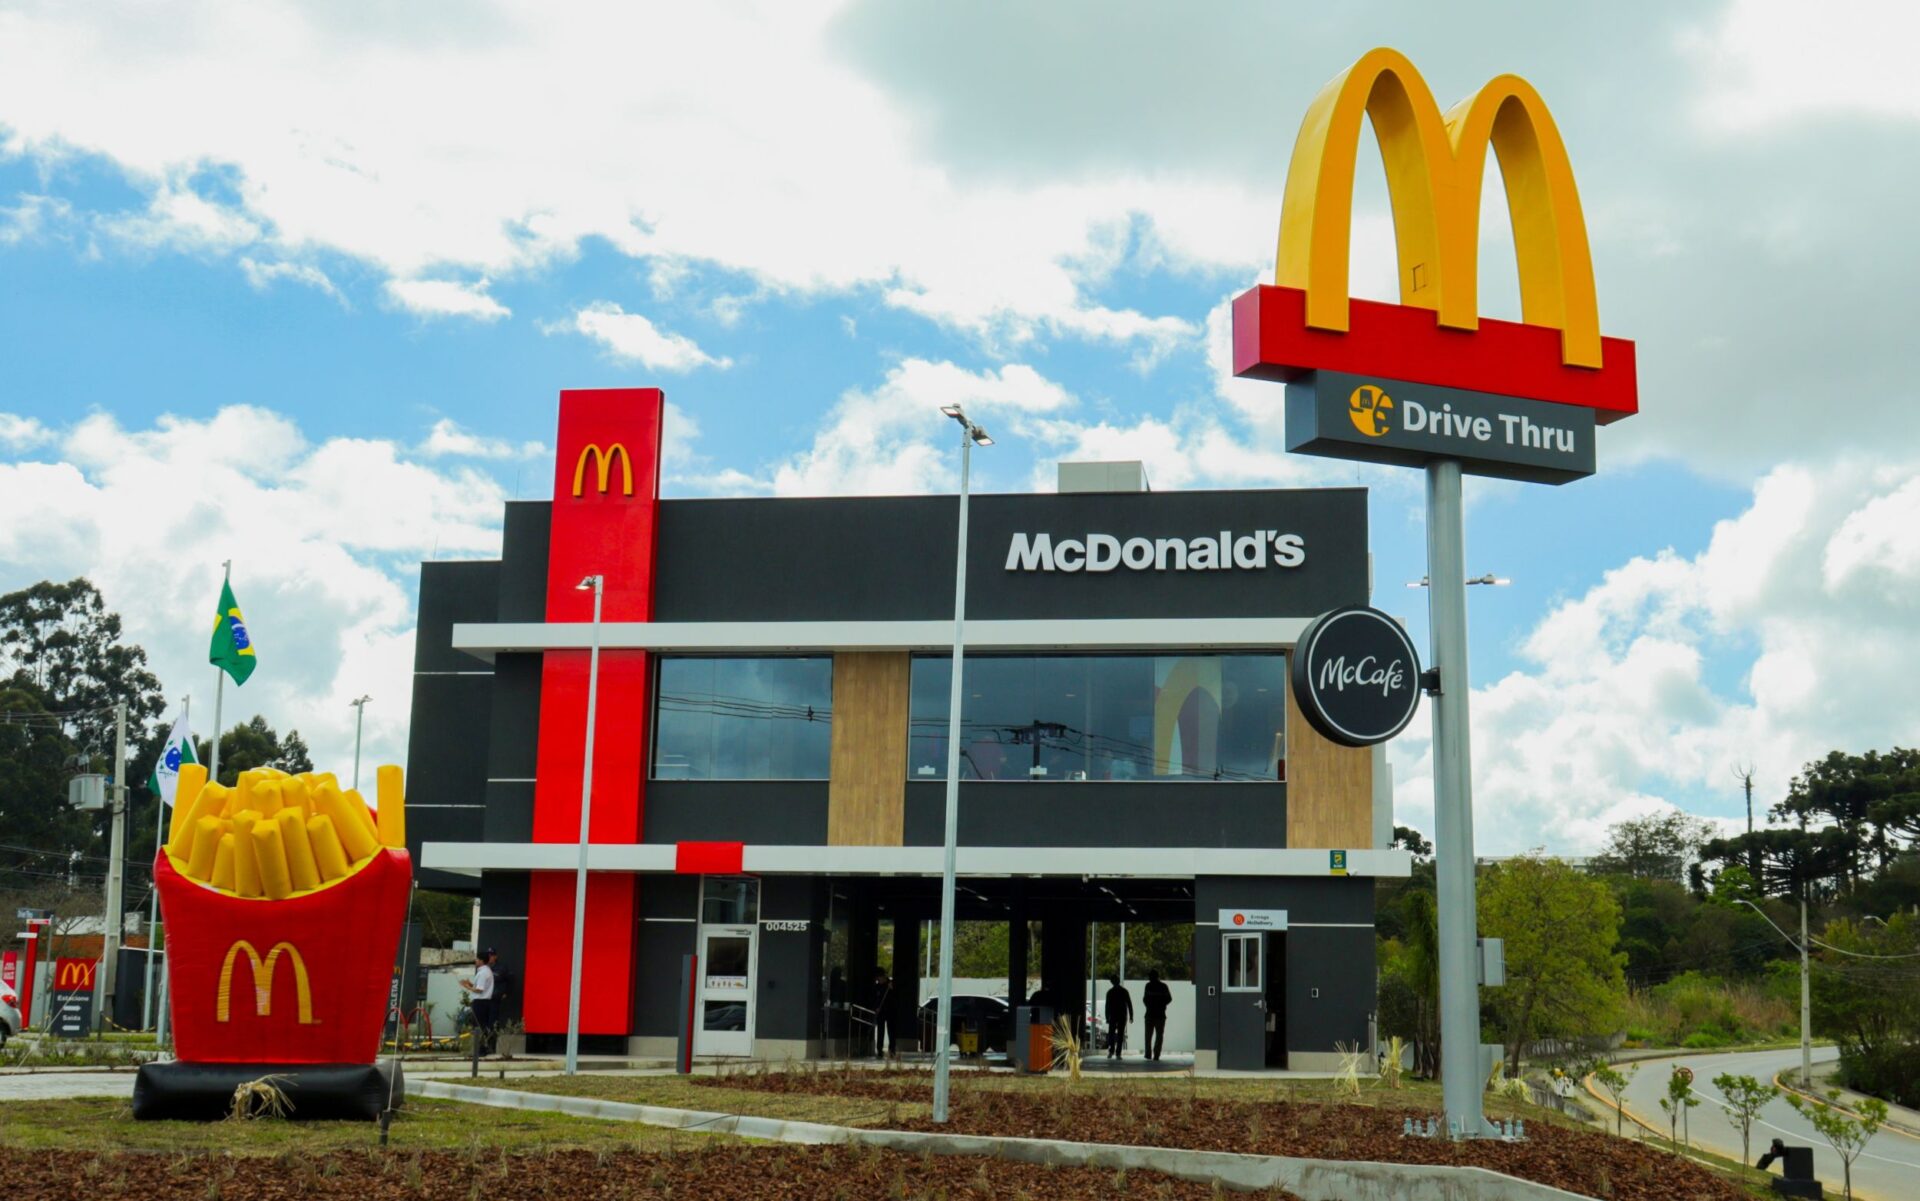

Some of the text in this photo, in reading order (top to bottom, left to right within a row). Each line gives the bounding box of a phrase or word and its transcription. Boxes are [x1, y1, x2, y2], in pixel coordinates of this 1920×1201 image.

[1402, 399, 1576, 454] Drive Thru
[1004, 529, 1306, 573] McDonald's
[1319, 655, 1403, 698] McCafé
[766, 922, 807, 931] 004525
